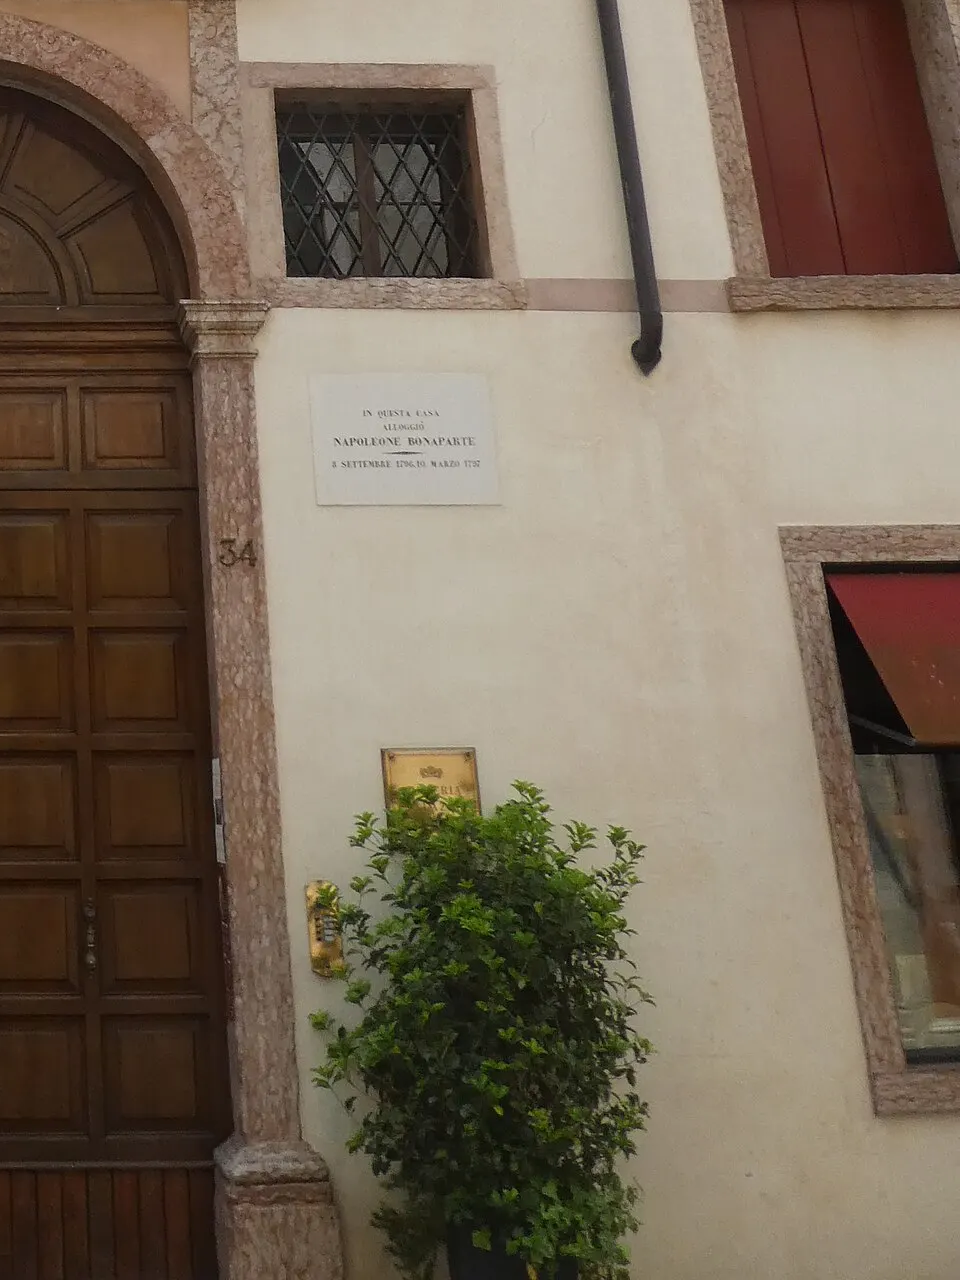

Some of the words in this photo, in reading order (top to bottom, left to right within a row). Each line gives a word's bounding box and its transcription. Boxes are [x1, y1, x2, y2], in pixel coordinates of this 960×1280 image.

[362, 409, 373, 417] IN
[377, 409, 411, 418] QUESTA
[415, 409, 440, 417] CASA
[334, 437, 401, 447] NAPOLEONE
[408, 437, 476, 447] BONAPARTE
[341, 460, 392, 469] SETTEMBRE
[431, 460, 460, 469] MARZO
[219, 538, 258, 567] 34
